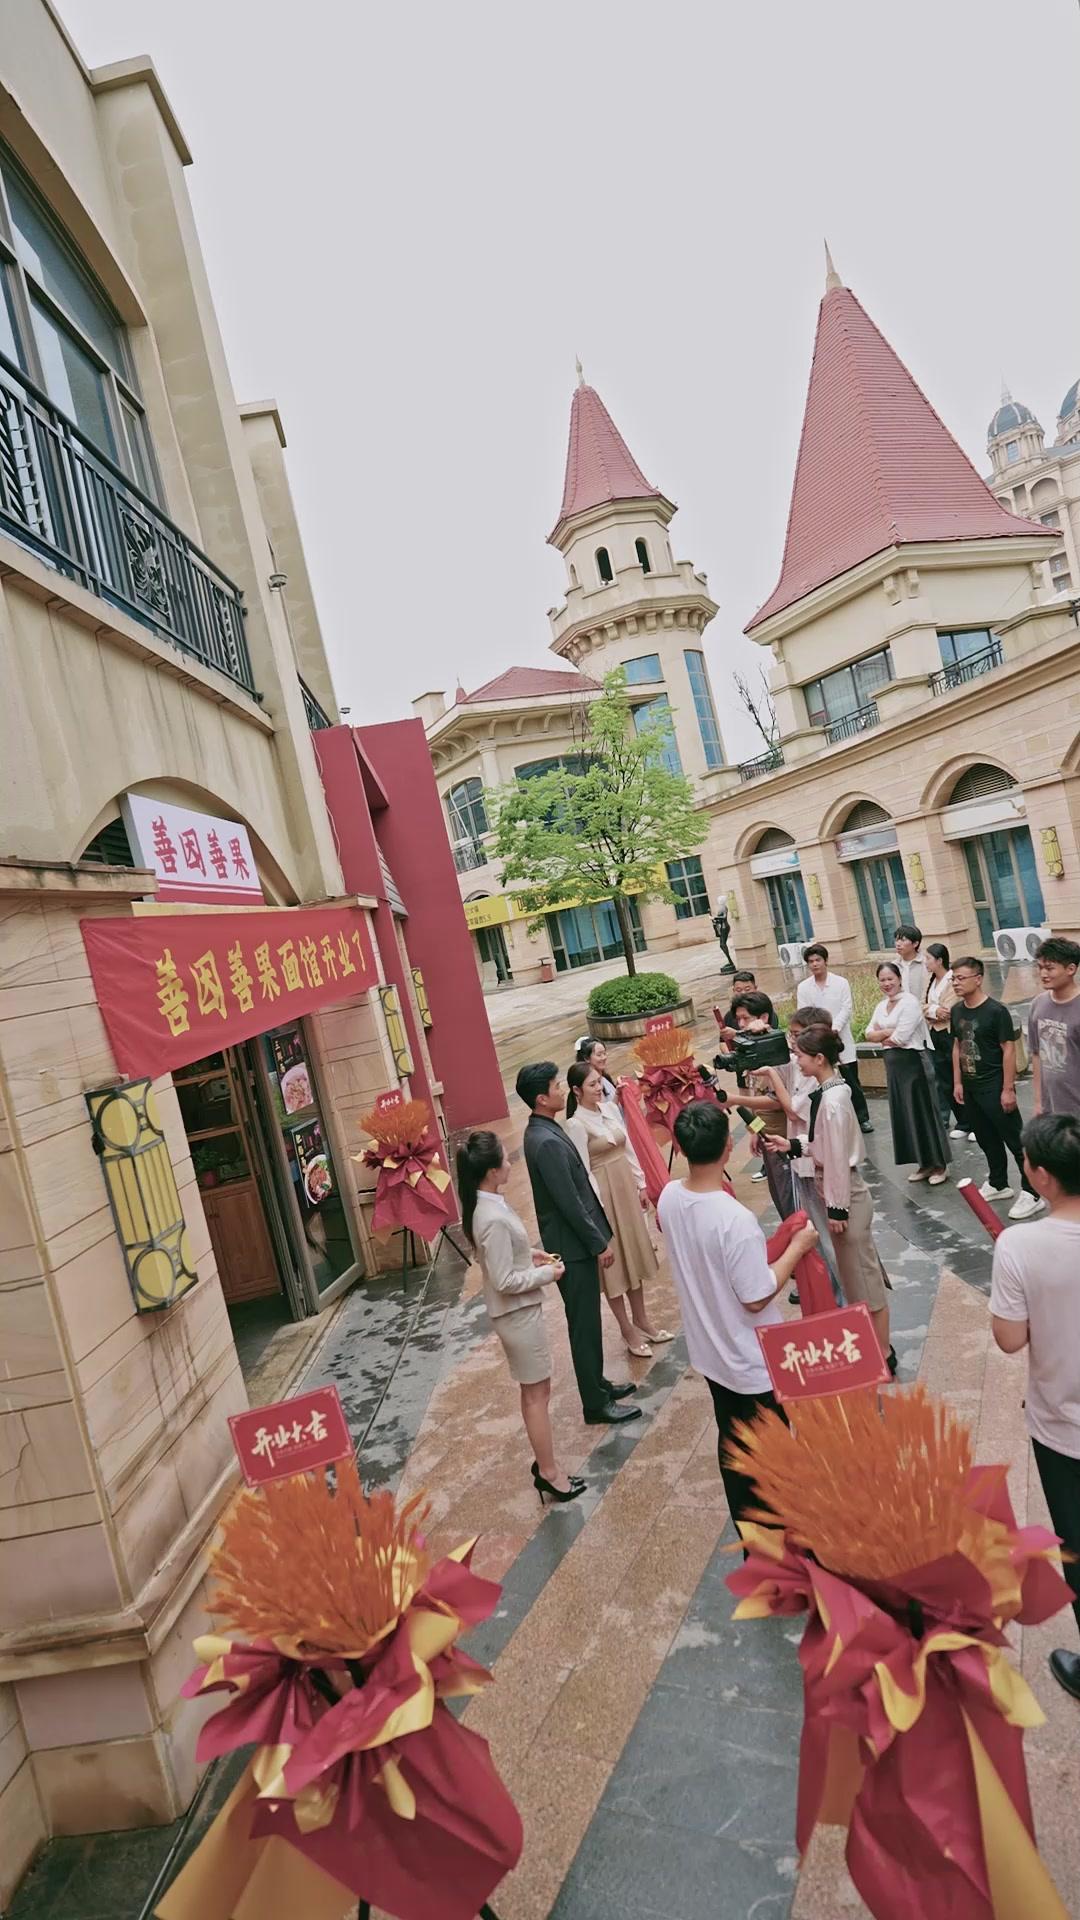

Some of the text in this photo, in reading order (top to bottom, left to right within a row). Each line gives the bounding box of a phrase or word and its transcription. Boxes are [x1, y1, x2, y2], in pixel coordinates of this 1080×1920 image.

[151, 815, 251, 881] 善因善果
[154, 928, 368, 1038] 善因善果面馆开业了
[780, 1328, 863, 1386] 开业大吉
[251, 1410, 329, 1468] 开业大吉
